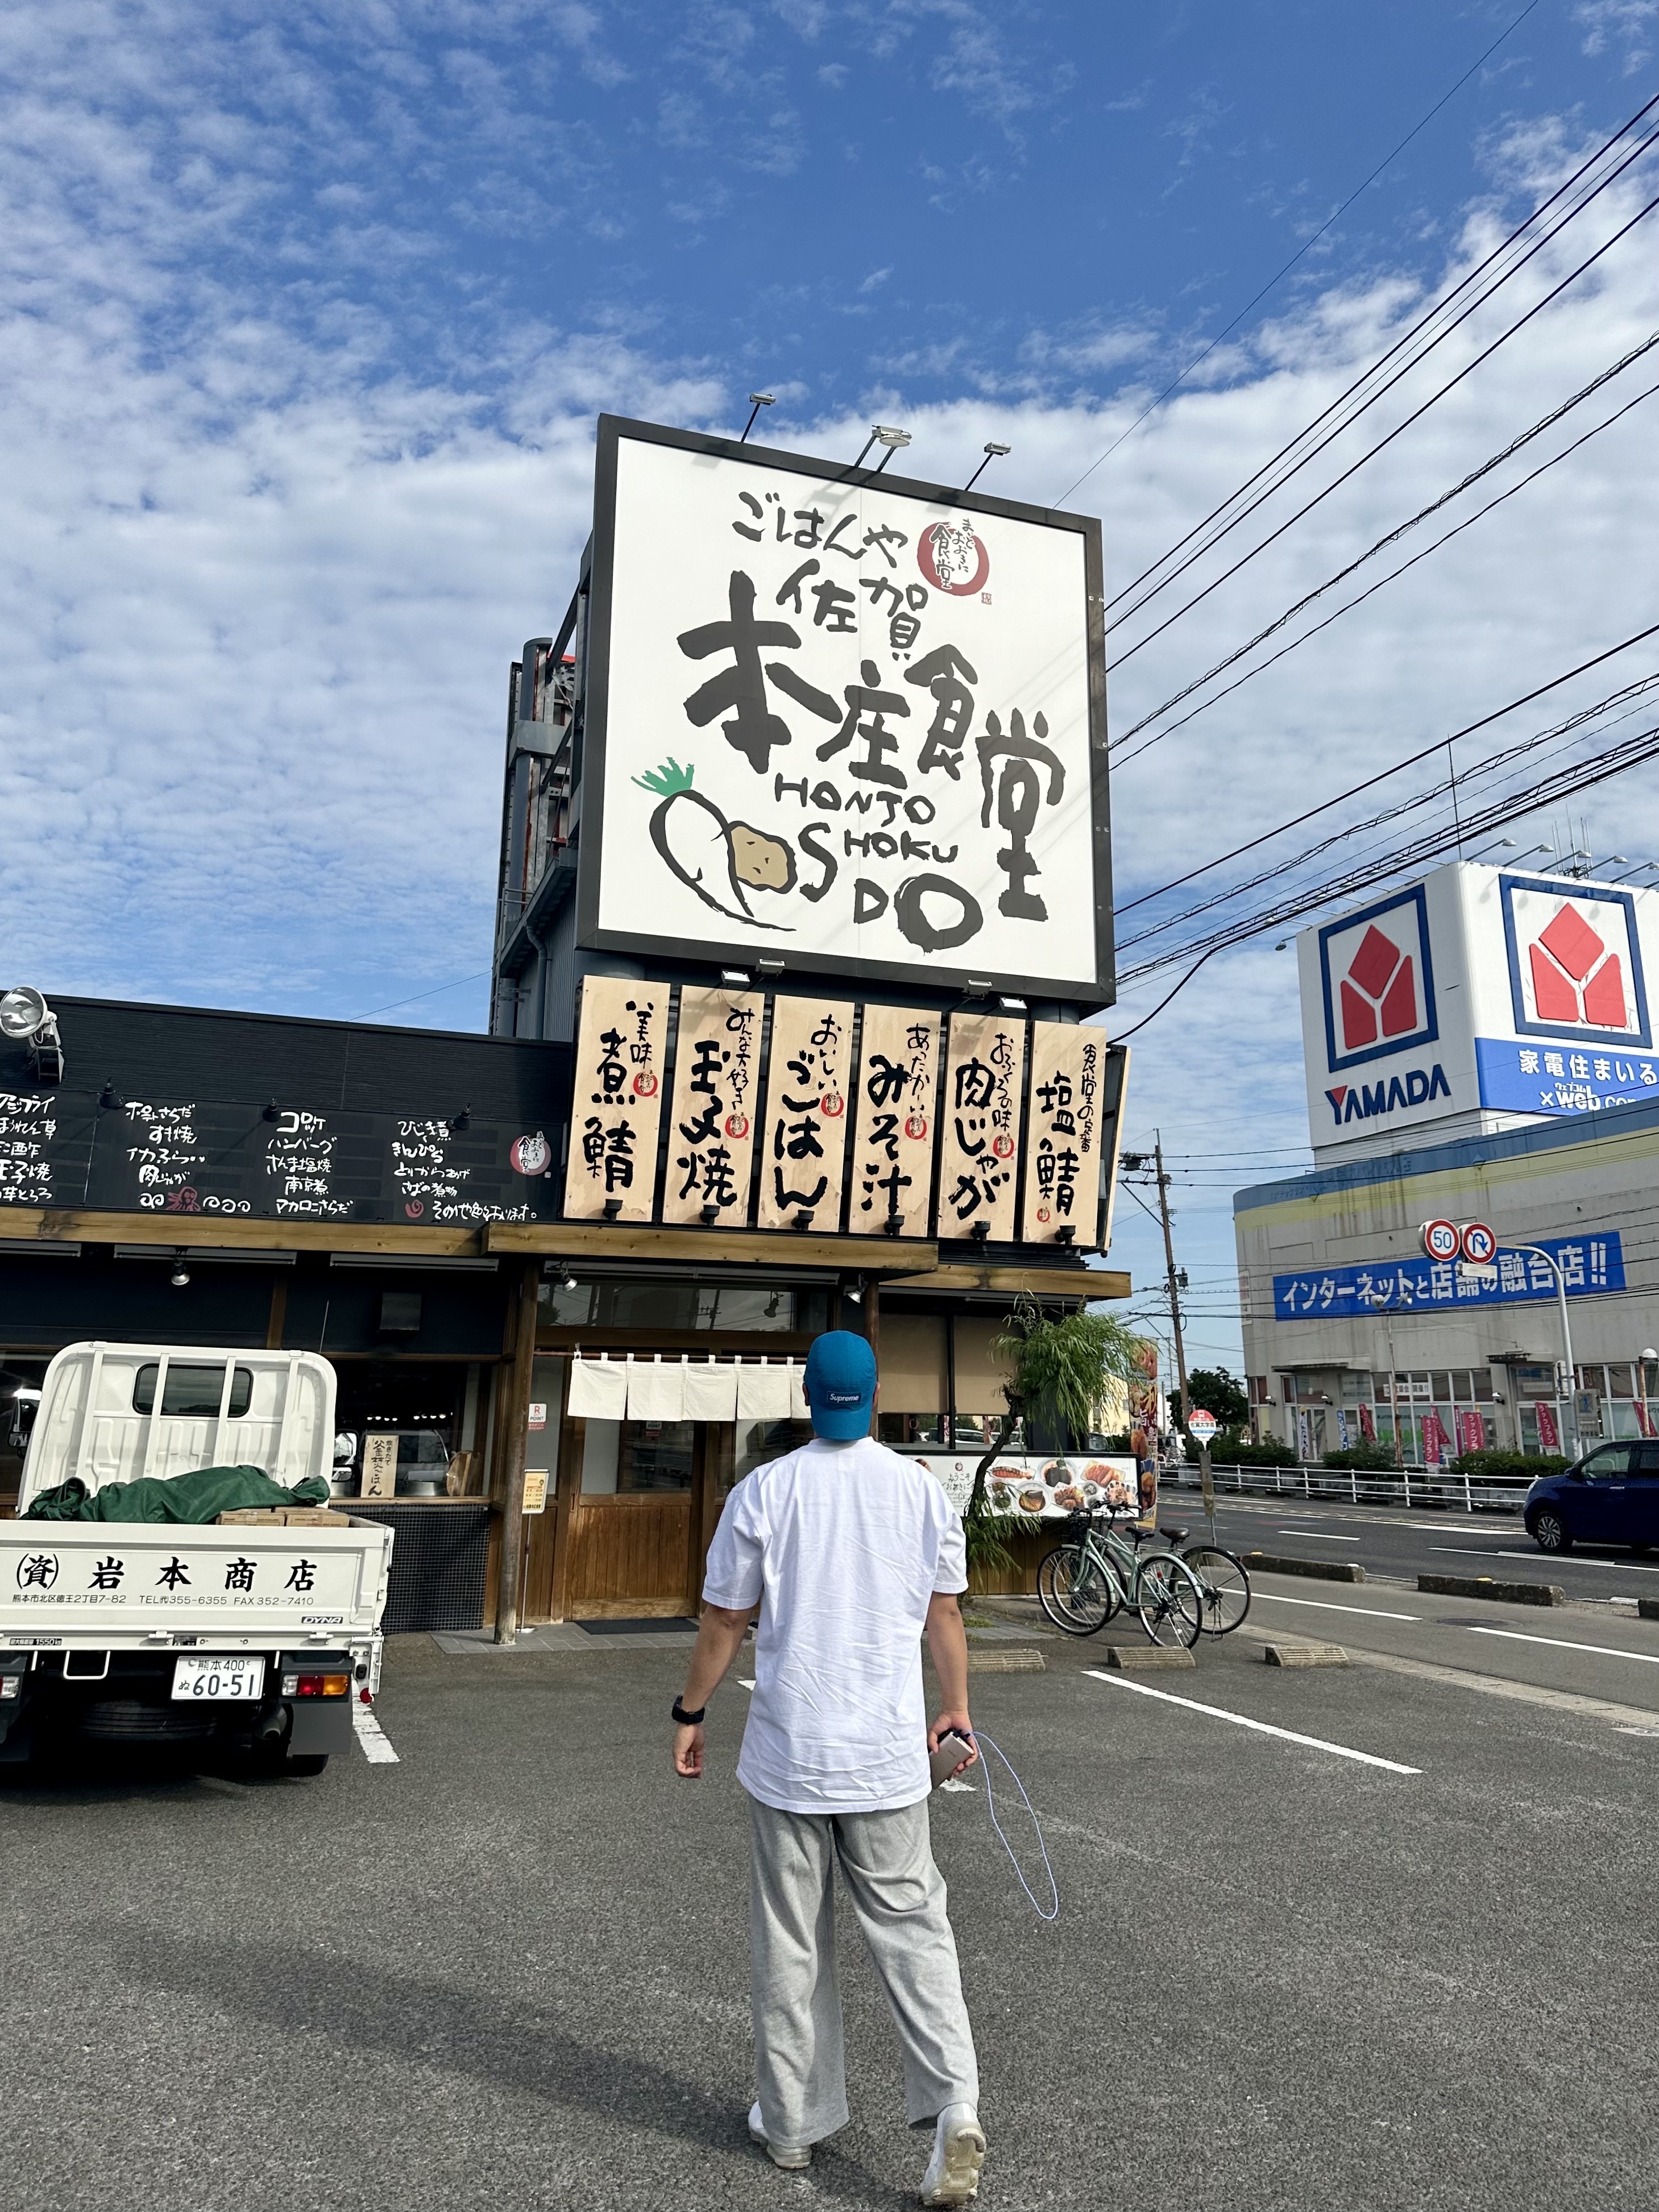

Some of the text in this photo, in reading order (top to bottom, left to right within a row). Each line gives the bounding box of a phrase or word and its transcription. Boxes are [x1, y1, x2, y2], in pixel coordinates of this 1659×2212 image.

[733, 491, 908, 567] ごはんや
[931, 525, 955, 588] 食堂
[952, 530, 969, 572] おおきに
[962, 518, 975, 549] まいど
[777, 559, 928, 660] 佐賀
[677, 570, 1066, 922] 本庄食堂
[775, 774, 936, 824] HONJO
[800, 823, 958, 902] SHOKU
[853, 873, 983, 953] DO
[626, 1001, 654, 1069] 美味
[726, 1008, 756, 1110] みんな大好き
[811, 1014, 842, 1090] おいしい
[990, 1033, 1016, 1131] おふくろの味
[1324, 1064, 1451, 1124] YAMADA
[1519, 1049, 1657, 1086] 家電住まいる
[276, 1111, 326, 1134] コロッケ
[583, 1027, 636, 1192] 煮鯖
[677, 1040, 738, 1206] 玉子焼
[1077, 1044, 1097, 1153] 食堂の定番
[148, 1124, 198, 1144] すき焼
[268, 1136, 338, 1155] ハンバーグ
[391, 1141, 443, 1164] きんぴら
[398, 1120, 451, 1143] ひじき煮
[774, 1050, 828, 1210] ごはん
[861, 1055, 913, 1215] みそ汁
[948, 1057, 1010, 1220] 肉じゃが
[1036, 1070, 1080, 1217] 塩鯖
[139, 1164, 190, 1187] 肉じゃが
[265, 1154, 332, 1175] さんま塩焼
[285, 1175, 329, 1196] 南京煮
[276, 1199, 354, 1215] マカロニさらだ
[1433, 1231, 1452, 1249] 50
[830, 1393, 859, 1403] Supreme
[234, 1597, 255, 1605] FAX
[256, 1597, 314, 1605] 352-7410
[178, 1674, 254, 1696] ぬ 60-51
